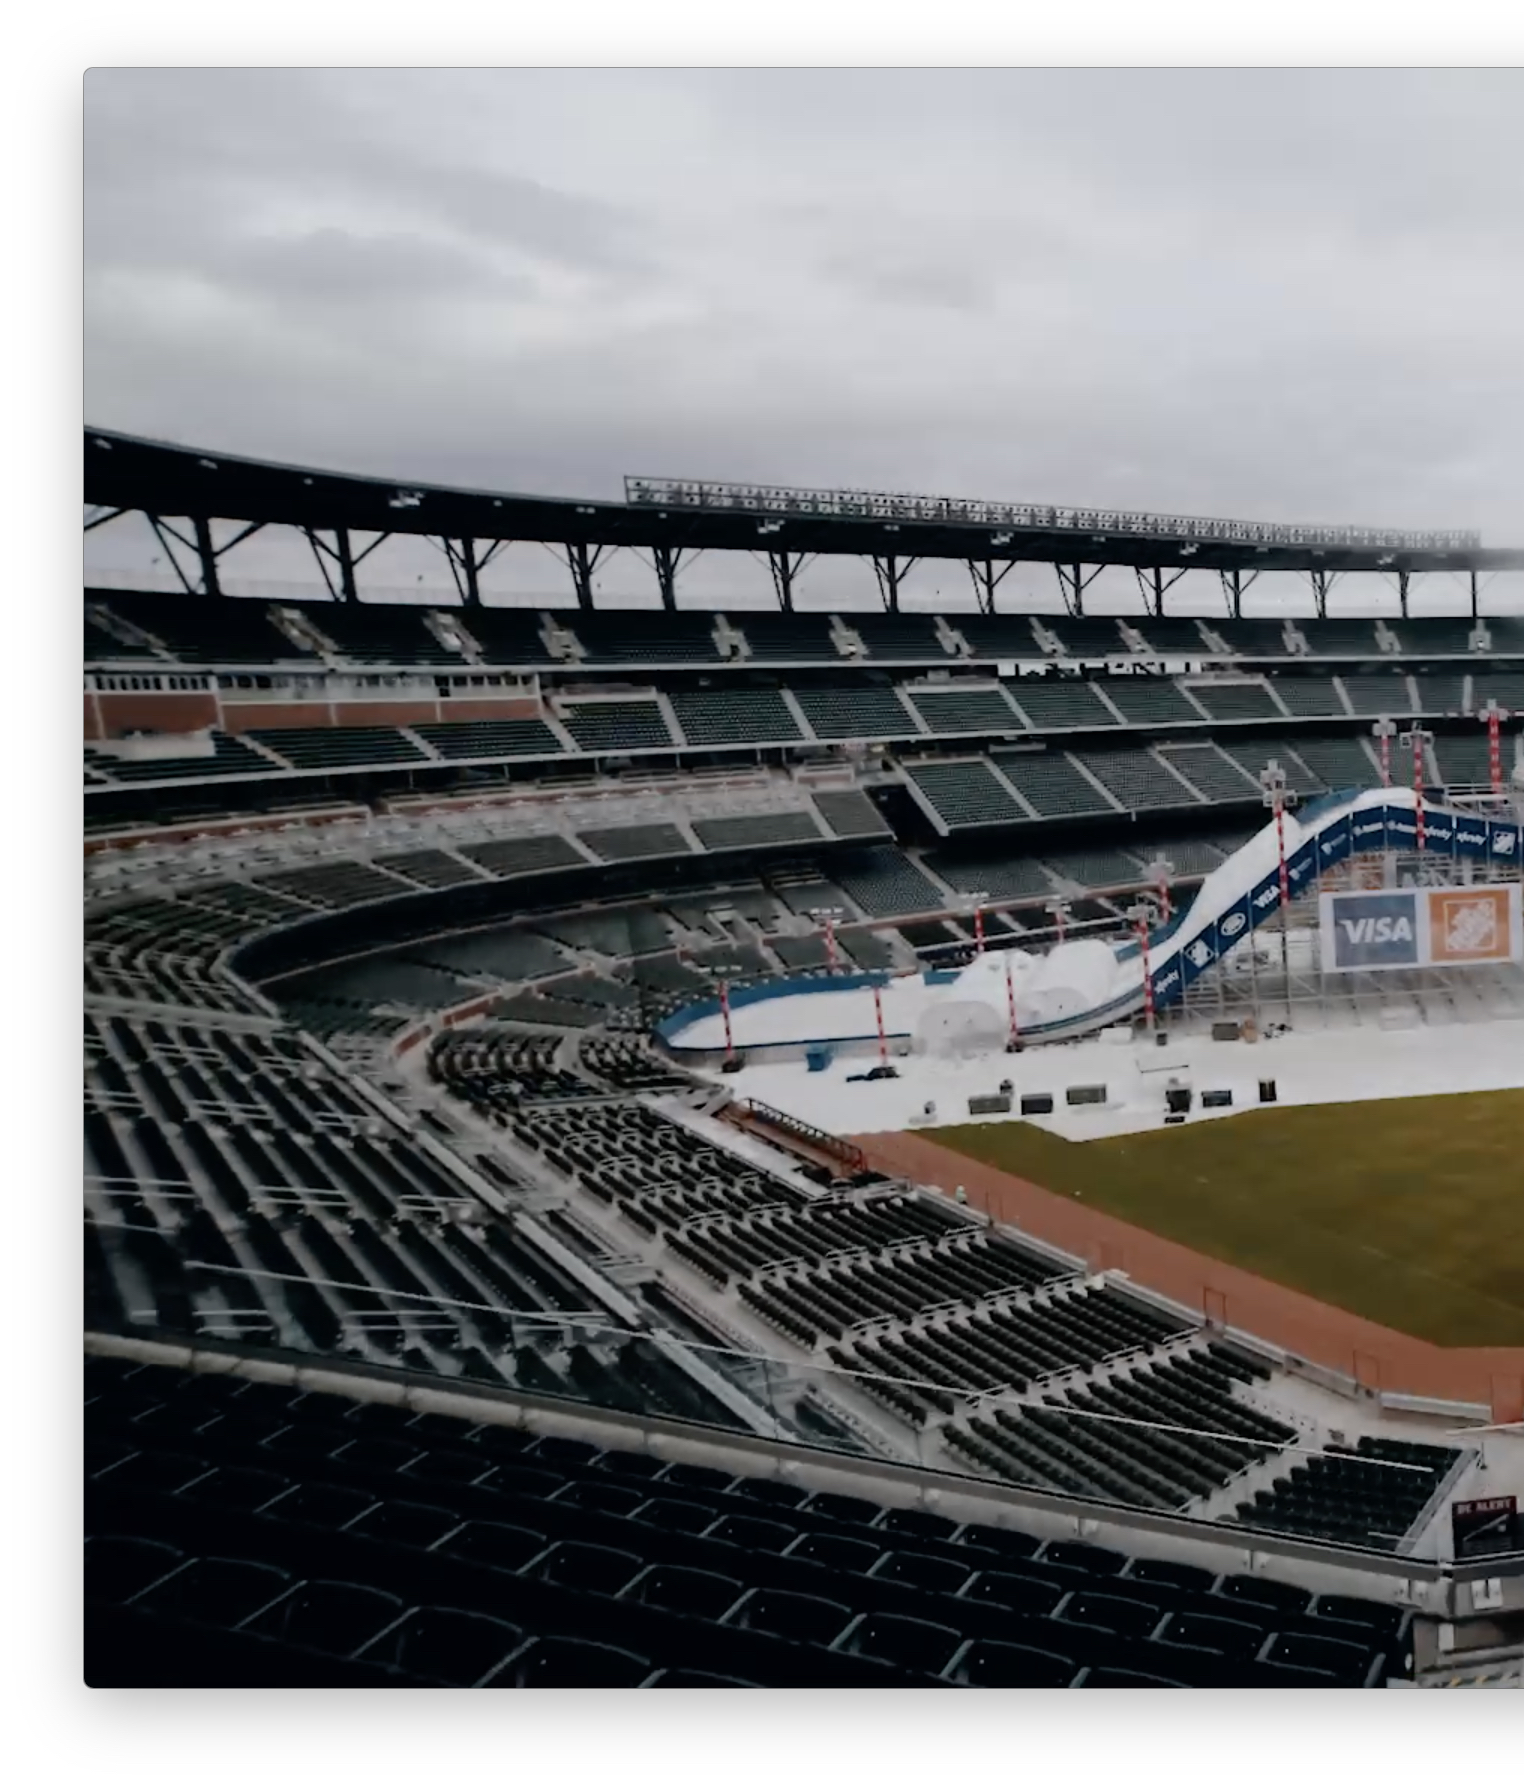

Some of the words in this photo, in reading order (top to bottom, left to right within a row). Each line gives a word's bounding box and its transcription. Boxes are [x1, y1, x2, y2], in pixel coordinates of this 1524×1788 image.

[1252, 885, 1280, 908] VISA
[1339, 916, 1413, 945] VISA
[1457, 1503, 1473, 1514] BE
[1476, 1499, 1512, 1512] ALERT
